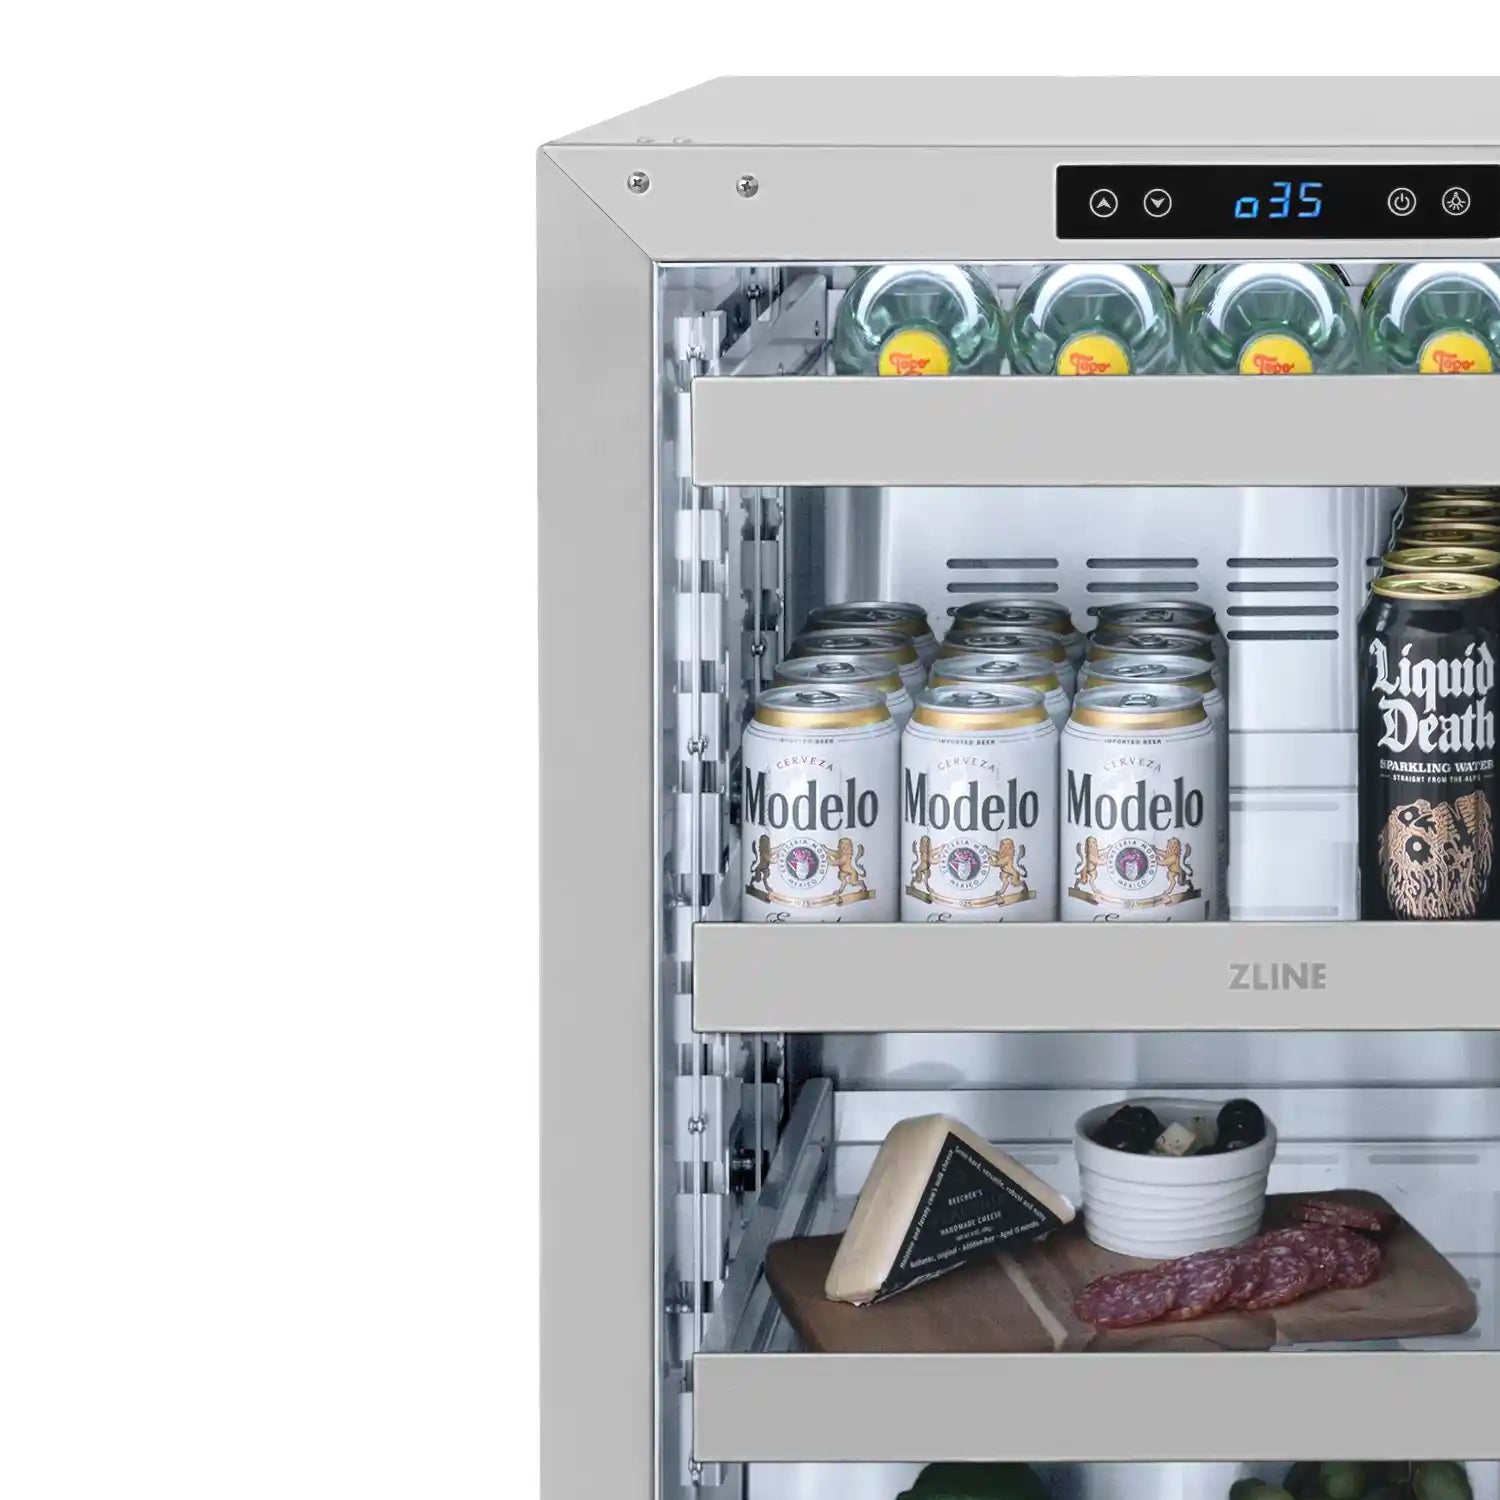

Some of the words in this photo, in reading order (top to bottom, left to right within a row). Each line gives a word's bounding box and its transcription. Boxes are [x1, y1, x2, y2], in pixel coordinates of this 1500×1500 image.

[1432, 350, 1475, 374] Topo
[1369, 637, 1495, 714] Liquid
[1377, 695, 1495, 753] Death
[776, 756, 834, 771] CERVEZA
[937, 756, 996, 772] CERVEZA
[1103, 757, 1161, 772] CERVEZA
[1380, 758, 1451, 773] SPARKLING
[1454, 759, 1494, 773] WATER
[745, 766, 879, 831] Modelo
[904, 767, 1039, 832] Modelo
[1067, 768, 1204, 832] Modelo
[1228, 962, 1327, 991] ZLINE
